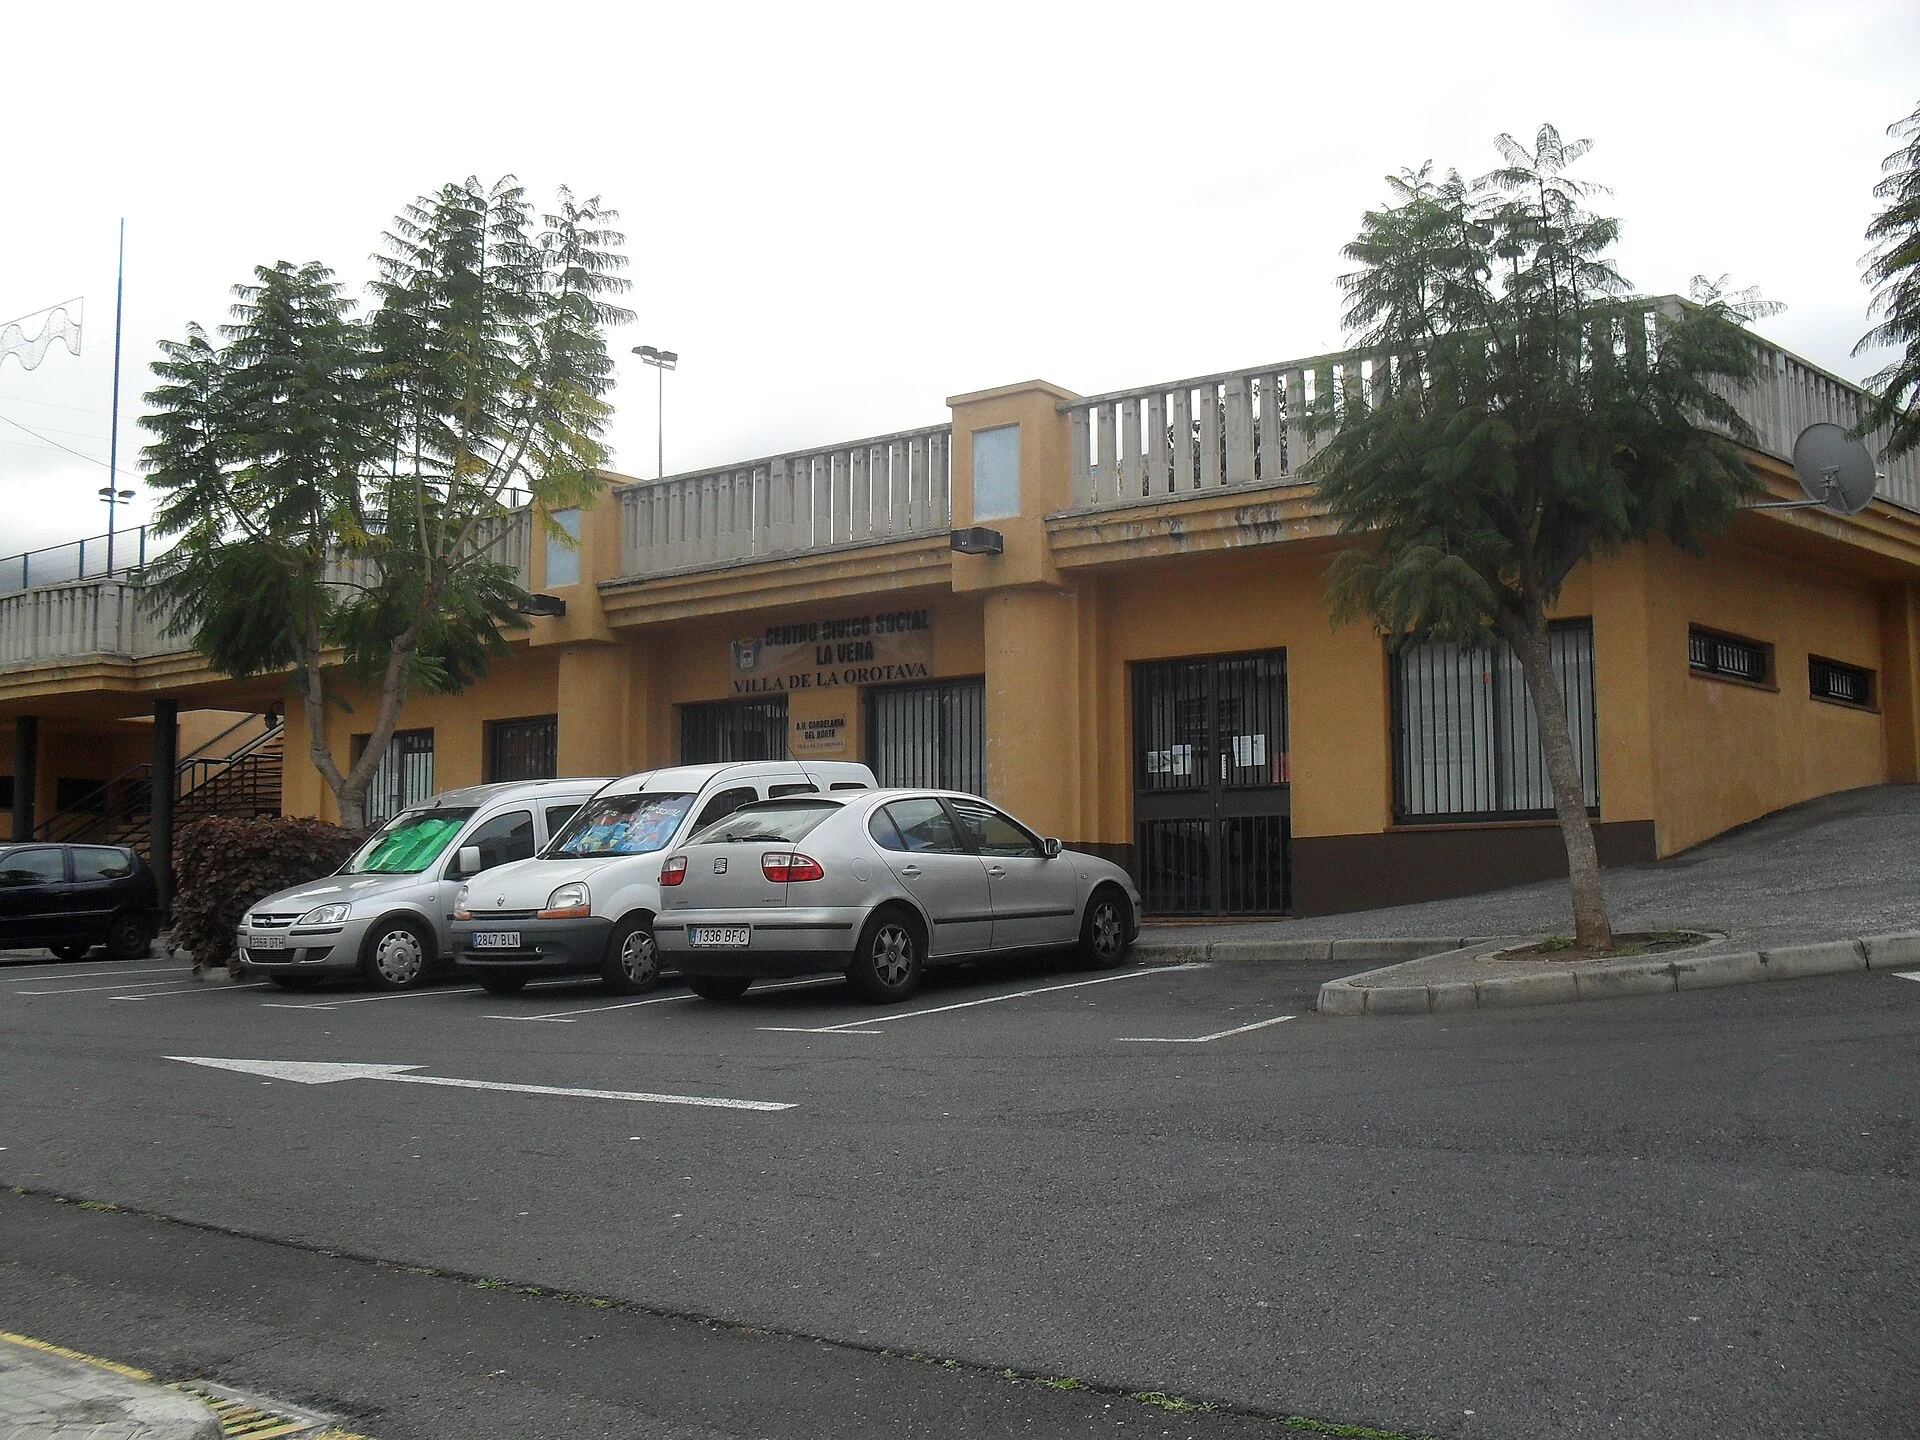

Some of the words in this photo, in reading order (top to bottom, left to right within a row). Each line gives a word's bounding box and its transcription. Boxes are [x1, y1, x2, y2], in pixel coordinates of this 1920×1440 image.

[816, 646, 833, 665] LA
[837, 641, 875, 663] VERA
[734, 677, 783, 694] VILLA
[789, 674, 811, 689] DE
[817, 669, 838, 686] LA
[843, 663, 928, 684] OROTAVA
[805, 731, 815, 739] DEL
[817, 729, 835, 738] NORTE
[477, 934, 497, 945] 2847
[501, 934, 519, 945] BLN
[699, 930, 721, 942] 1336
[725, 929, 746, 942] BFC
